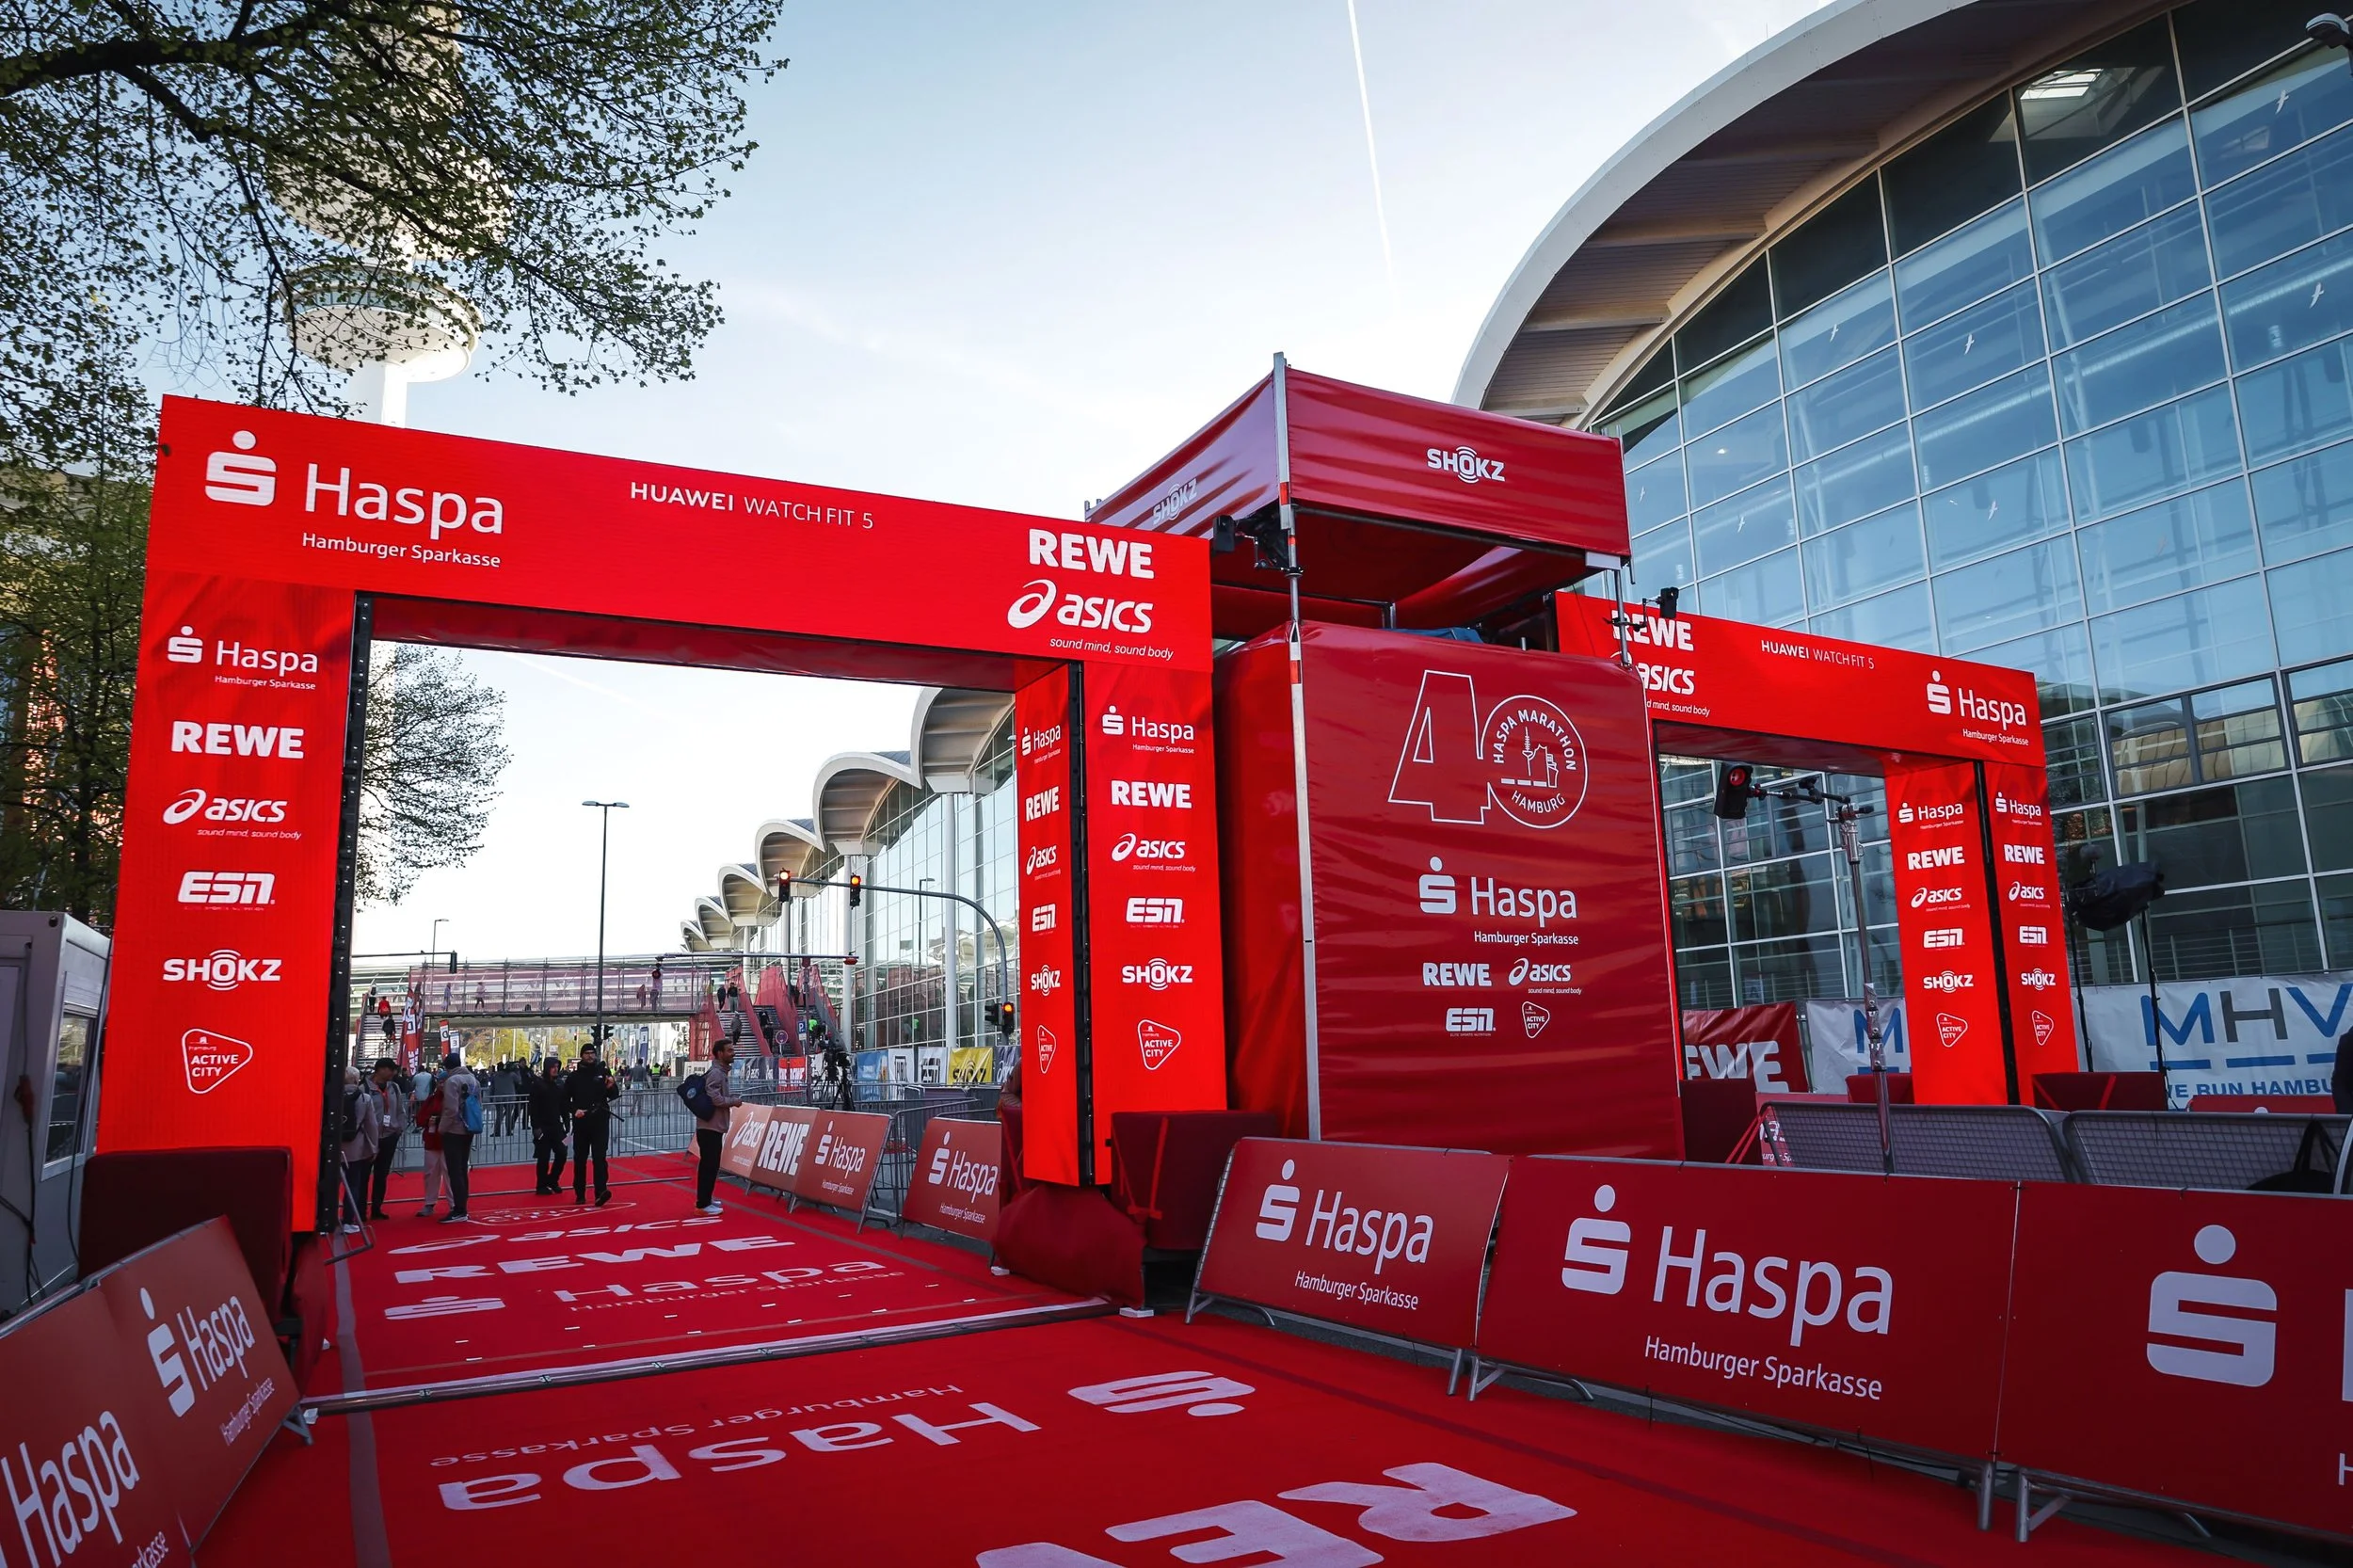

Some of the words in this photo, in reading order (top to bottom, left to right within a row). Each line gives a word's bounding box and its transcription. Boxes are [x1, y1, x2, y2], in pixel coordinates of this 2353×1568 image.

[1427, 446, 1505, 483] SHOKZ
[305, 462, 504, 540] Haspa
[631, 482, 734, 511] HUAWEI
[862, 512, 874, 529] 5
[1153, 477, 1197, 525] SHOKZ
[302, 533, 407, 559] Hamburger
[411, 543, 501, 568] Sparkasse
[1029, 528, 1155, 580] REWE
[216, 640, 318, 677] Haspa
[1049, 638, 1082, 649] sound
[1114, 645, 1146, 656] sound
[1147, 647, 1174, 661] body
[1761, 640, 1810, 659] HUAWEI
[1867, 657, 1875, 669] 5
[215, 676, 267, 688] Hamburger
[269, 679, 316, 690] Sparkasse
[1672, 703, 1692, 713] sound
[1693, 707, 1710, 717] body
[1958, 687, 2027, 730] Haspa
[171, 720, 305, 760] REWE
[1033, 725, 1061, 751] Haspa
[1131, 716, 1194, 744] Haspa
[1493, 715, 1518, 764] HASPA
[1517, 709, 1577, 771] MARATHON
[1962, 728, 1997, 744] Hamburger
[1998, 733, 2029, 746] Sparkasse
[1132, 744, 1165, 753] Hamburger
[1165, 745, 1194, 754] Sparkasse
[1025, 786, 1060, 822] REWE
[1111, 780, 1193, 808] REWE
[1512, 790, 1565, 814] HAMBURG
[1917, 803, 1963, 821] Haspa
[2009, 799, 2041, 819] Haspa
[1907, 846, 1965, 871] REWE
[2004, 843, 2045, 865] REWE
[1471, 875, 1578, 928] Haspa
[1474, 930, 1529, 946] Hamburger
[1530, 933, 1579, 946] Sparkasse
[163, 954, 282, 986] SHOKZ
[1031, 968, 1061, 993] SHOKZ
[1122, 962, 1193, 987] SHOKZ
[1422, 962, 1493, 986] REWE
[1923, 972, 1974, 991] SHOKZ
[2021, 970, 2056, 988] SHOKZ
[191, 1054, 239, 1064] ACTIVE
[1144, 1039, 1174, 1048] ACTIVE
[1145, 1048, 1164, 1058] CITY
[192, 1066, 222, 1077] CITY
[1685, 1040, 1790, 1093] EWE
[2197, 1082, 2244, 1096] RUN
[757, 1120, 809, 1176] REWE
[828, 1136, 866, 1179] Haspa
[947, 1150, 998, 1204] Haspa
[1305, 1190, 1434, 1275] Haspa
[394, 1235, 795, 1284] REWE
[553, 1259, 887, 1303] Haspa
[568, 1288, 750, 1313] Hamburger
[756, 1271, 905, 1291] Sparkasse
[1295, 1270, 1357, 1301] Hamburger
[1358, 1281, 1419, 1311] Sparkasse
[1653, 1225, 1893, 1348] Haspa
[176, 1295, 256, 1391] Haspa
[1644, 1335, 1760, 1379] Hamburger
[1765, 1355, 1882, 1401] Sparkasse
[709, 1384, 965, 1430] Hamburger
[430, 1423, 696, 1468] Sparkasse
[438, 1401, 1042, 1511] Haspa
[1, 1411, 140, 1568] Haspa
[976, 1463, 1578, 1568] RE
[132, 1530, 169, 1568] rkasse
